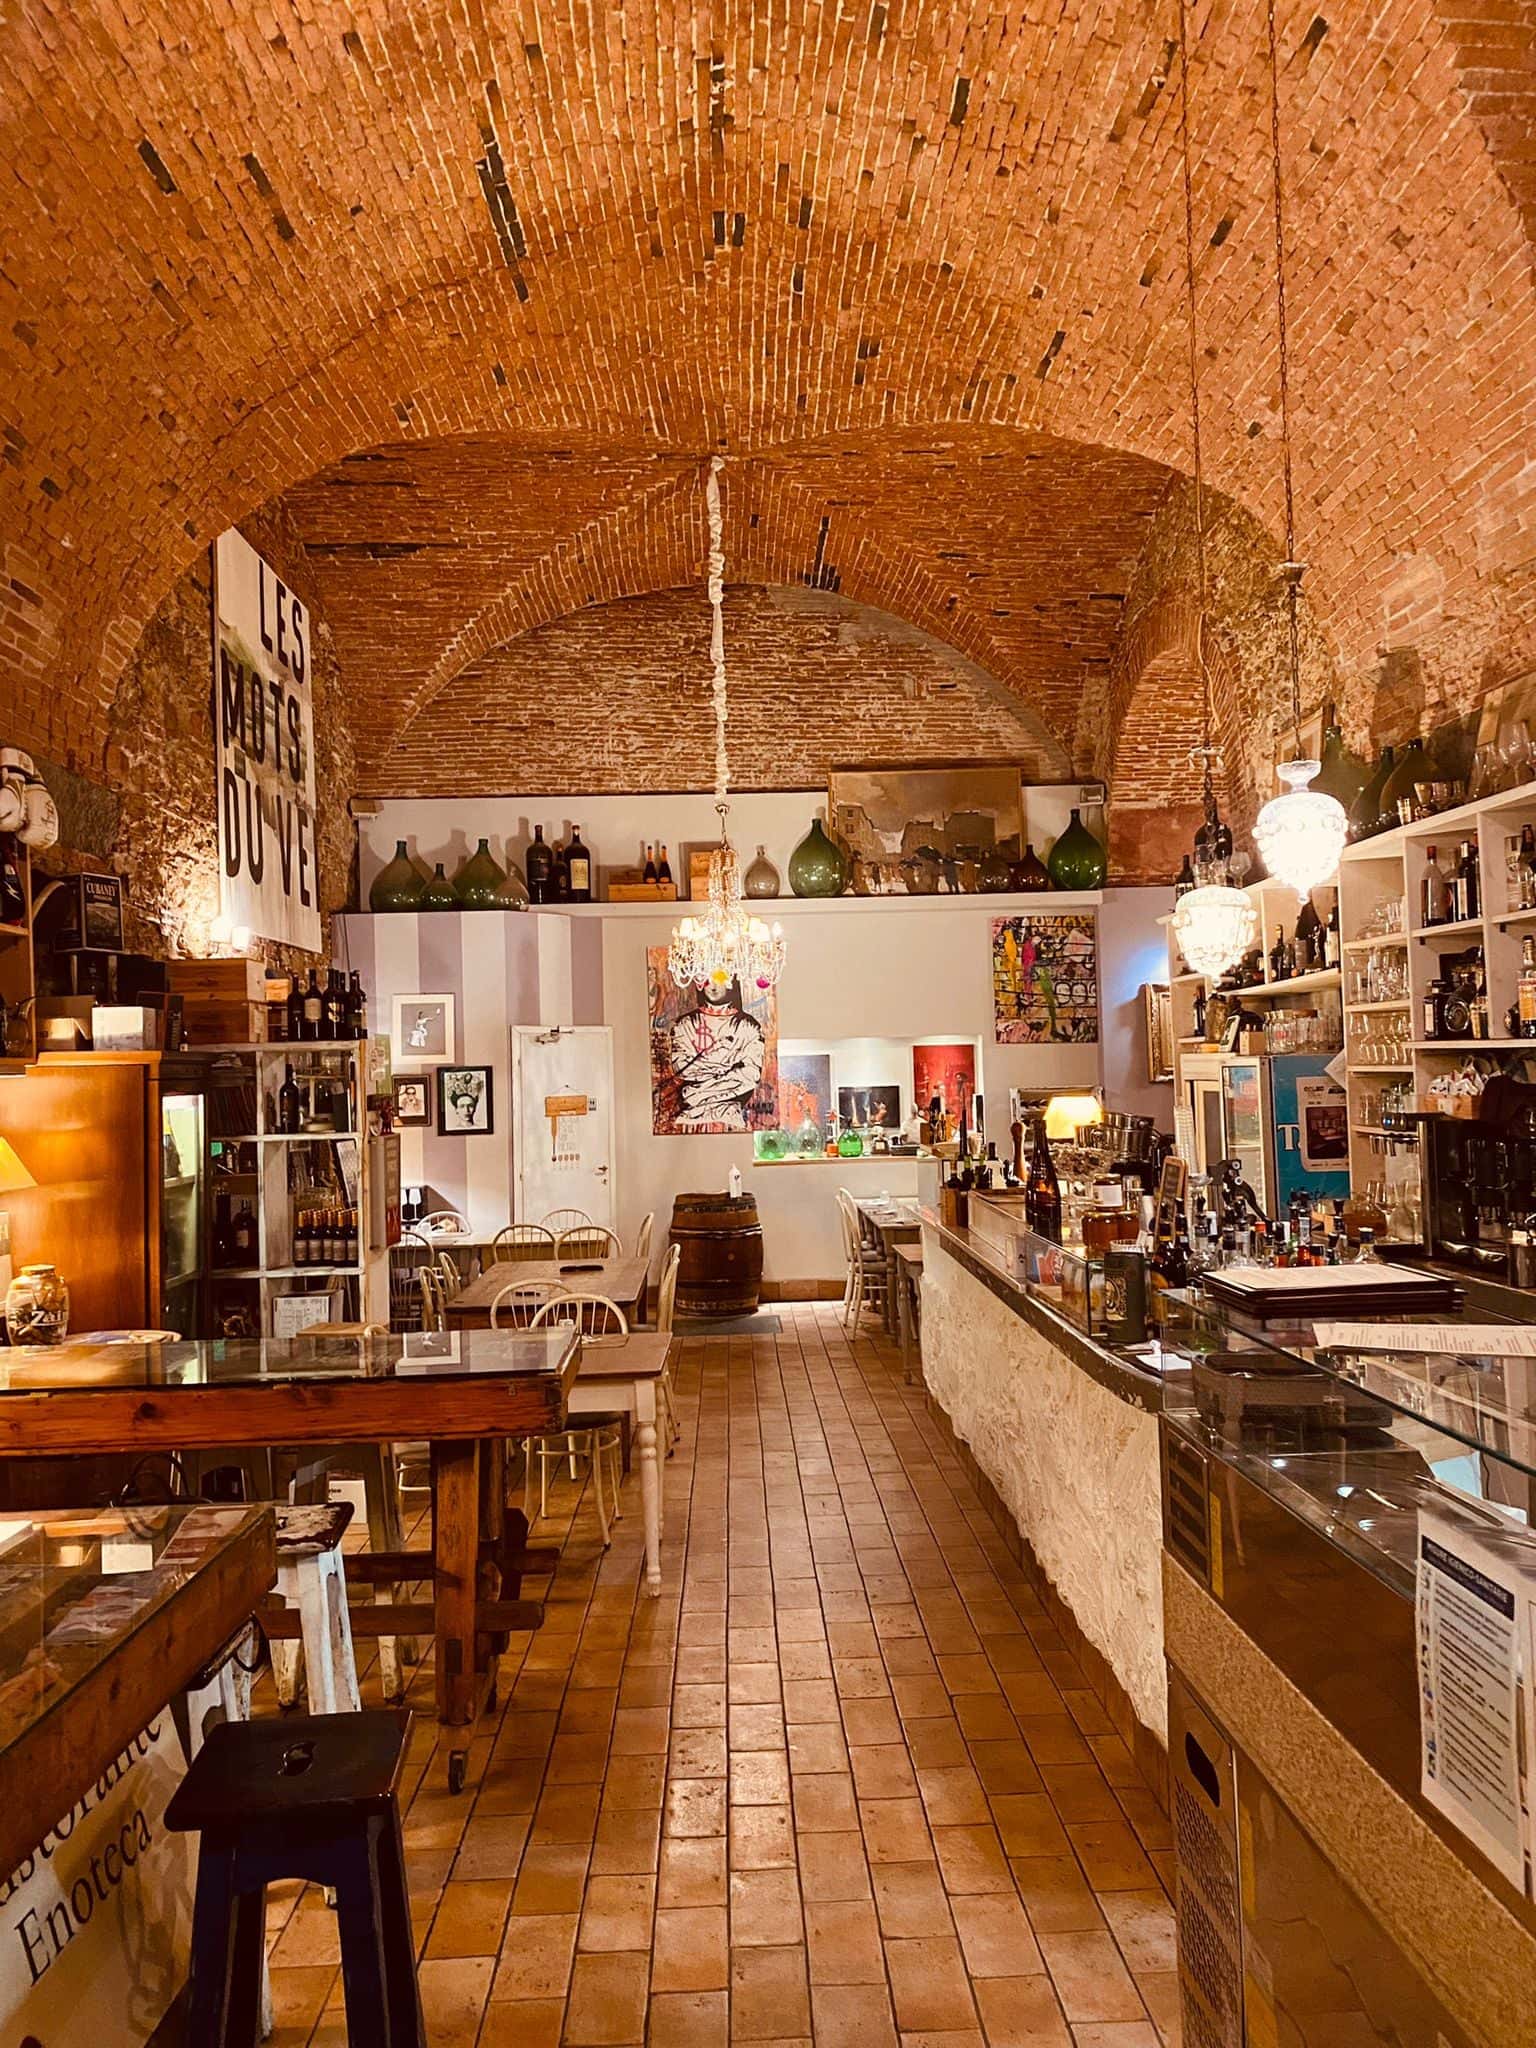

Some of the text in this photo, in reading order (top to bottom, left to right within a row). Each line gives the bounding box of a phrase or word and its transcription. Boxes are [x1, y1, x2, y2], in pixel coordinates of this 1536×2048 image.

[259, 559, 304, 684] LES
[221, 645, 301, 784] MOTS
[223, 766, 320, 913] DU VE
[14, 1808, 152, 1987] Enoteca
